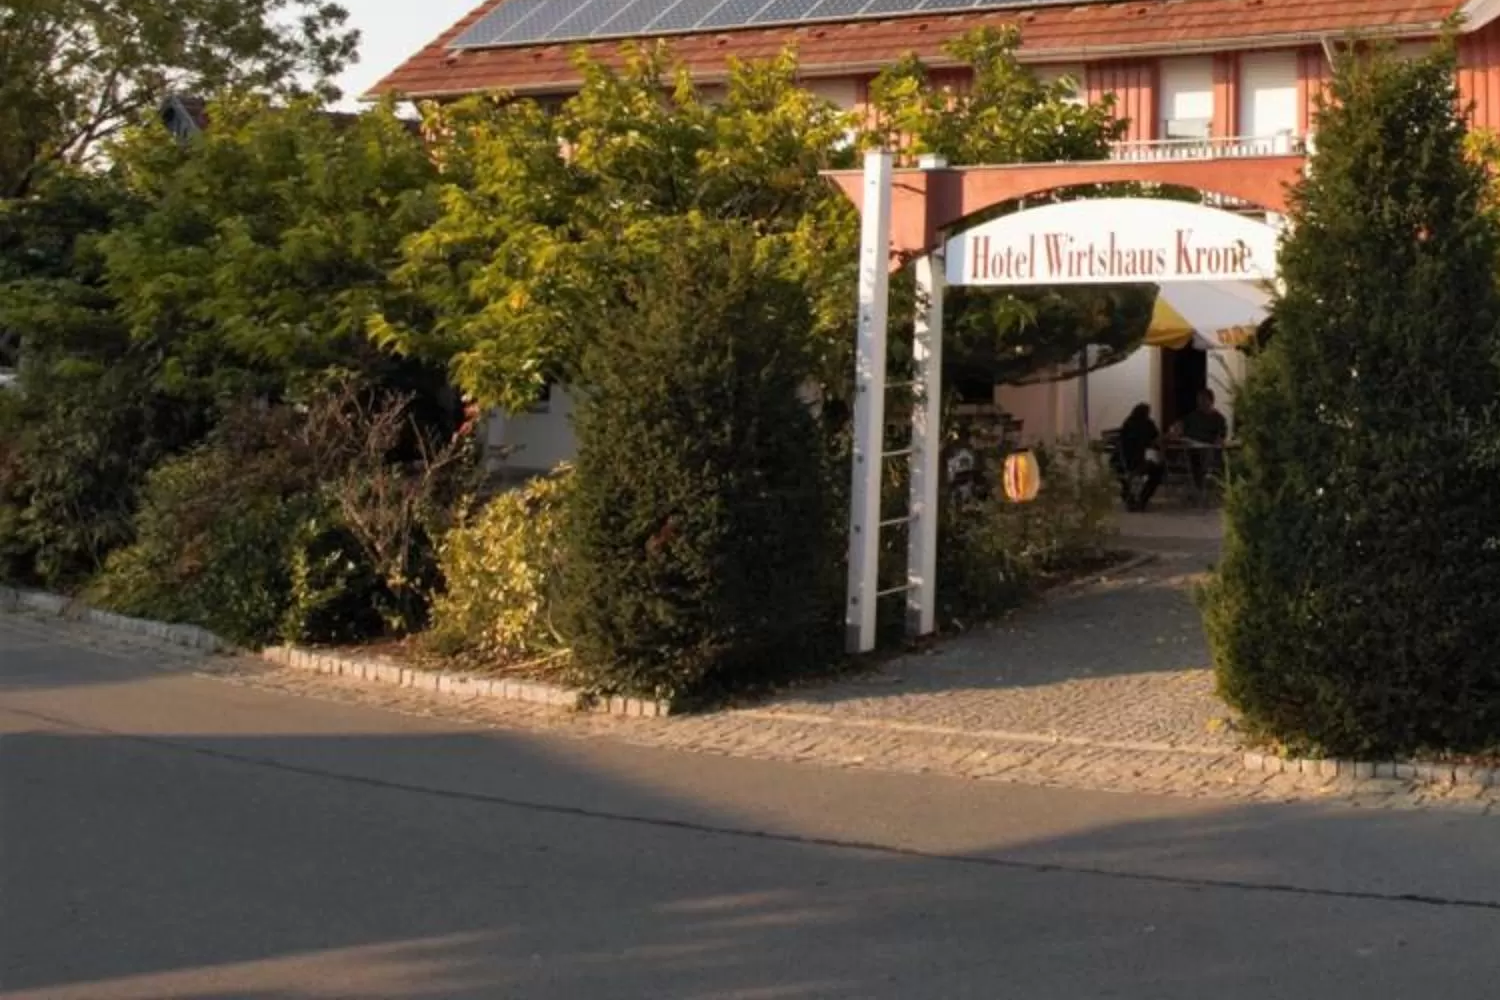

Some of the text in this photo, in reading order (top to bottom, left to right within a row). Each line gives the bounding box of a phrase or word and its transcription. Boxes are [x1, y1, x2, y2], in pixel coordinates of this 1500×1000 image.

[971, 228, 1252, 281] Hotel Wirtshaus Krone
